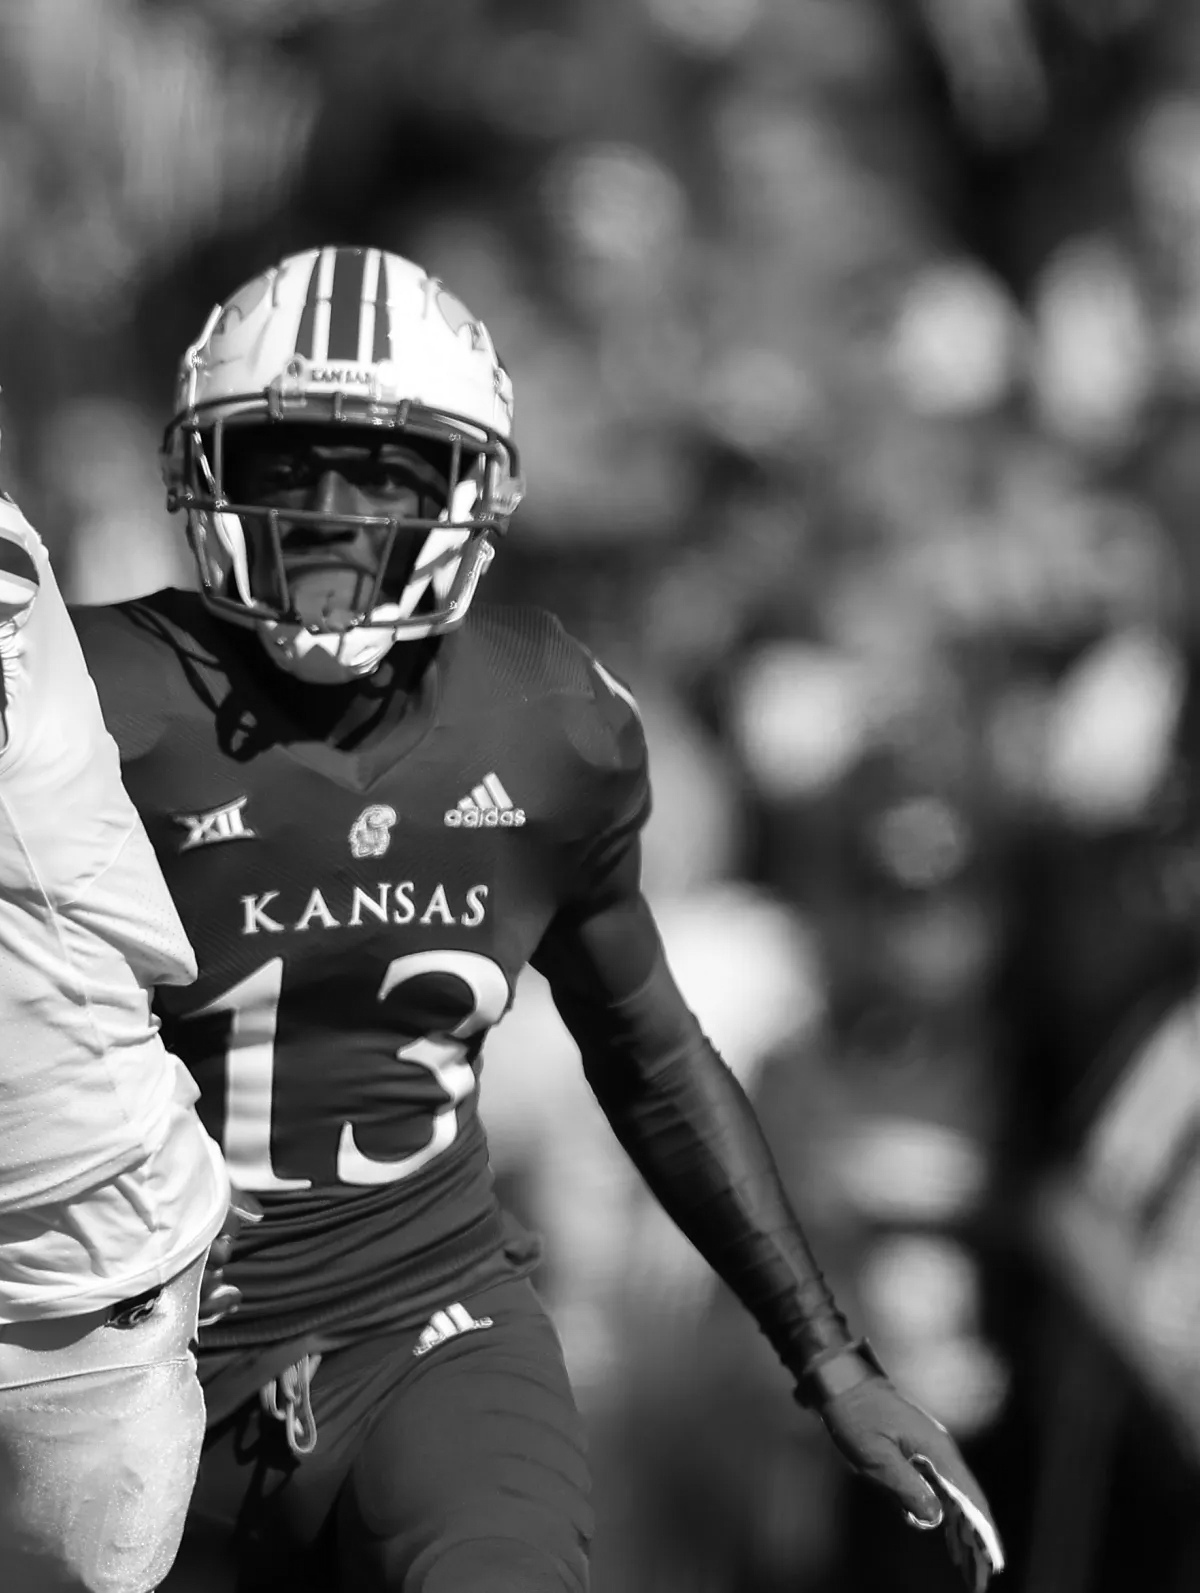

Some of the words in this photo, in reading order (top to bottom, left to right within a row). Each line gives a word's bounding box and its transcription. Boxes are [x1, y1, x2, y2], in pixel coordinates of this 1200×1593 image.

[443, 807, 526, 828] adidas
[241, 881, 489, 935] KANSAS
[181, 949, 509, 1191] 13
